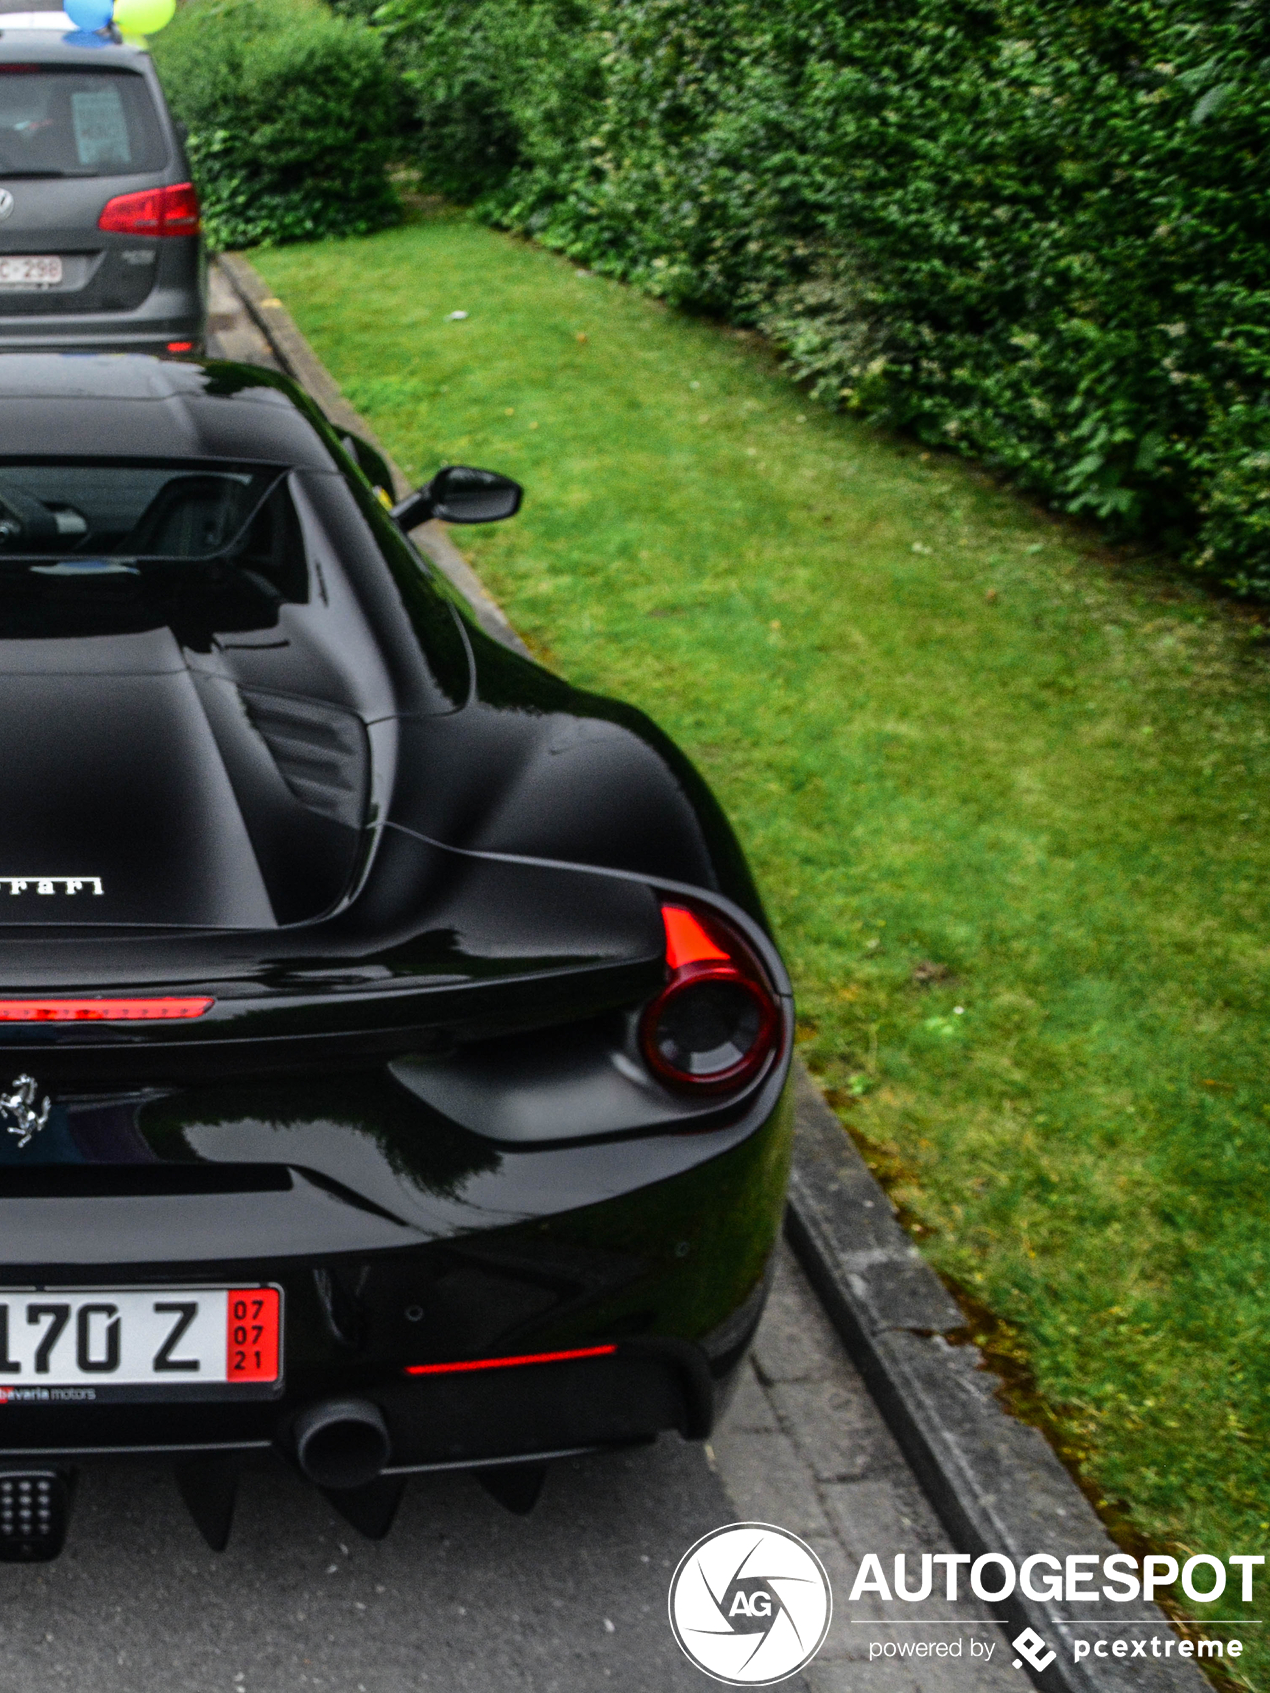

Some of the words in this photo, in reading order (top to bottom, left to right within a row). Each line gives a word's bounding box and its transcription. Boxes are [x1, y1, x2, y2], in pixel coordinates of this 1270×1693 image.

[234, 1300, 264, 1320] 07
[153, 1302, 200, 1371] Z
[234, 1326, 264, 1346] 07
[234, 1351, 264, 1371] 21
[51, 1388, 97, 1400] motors
